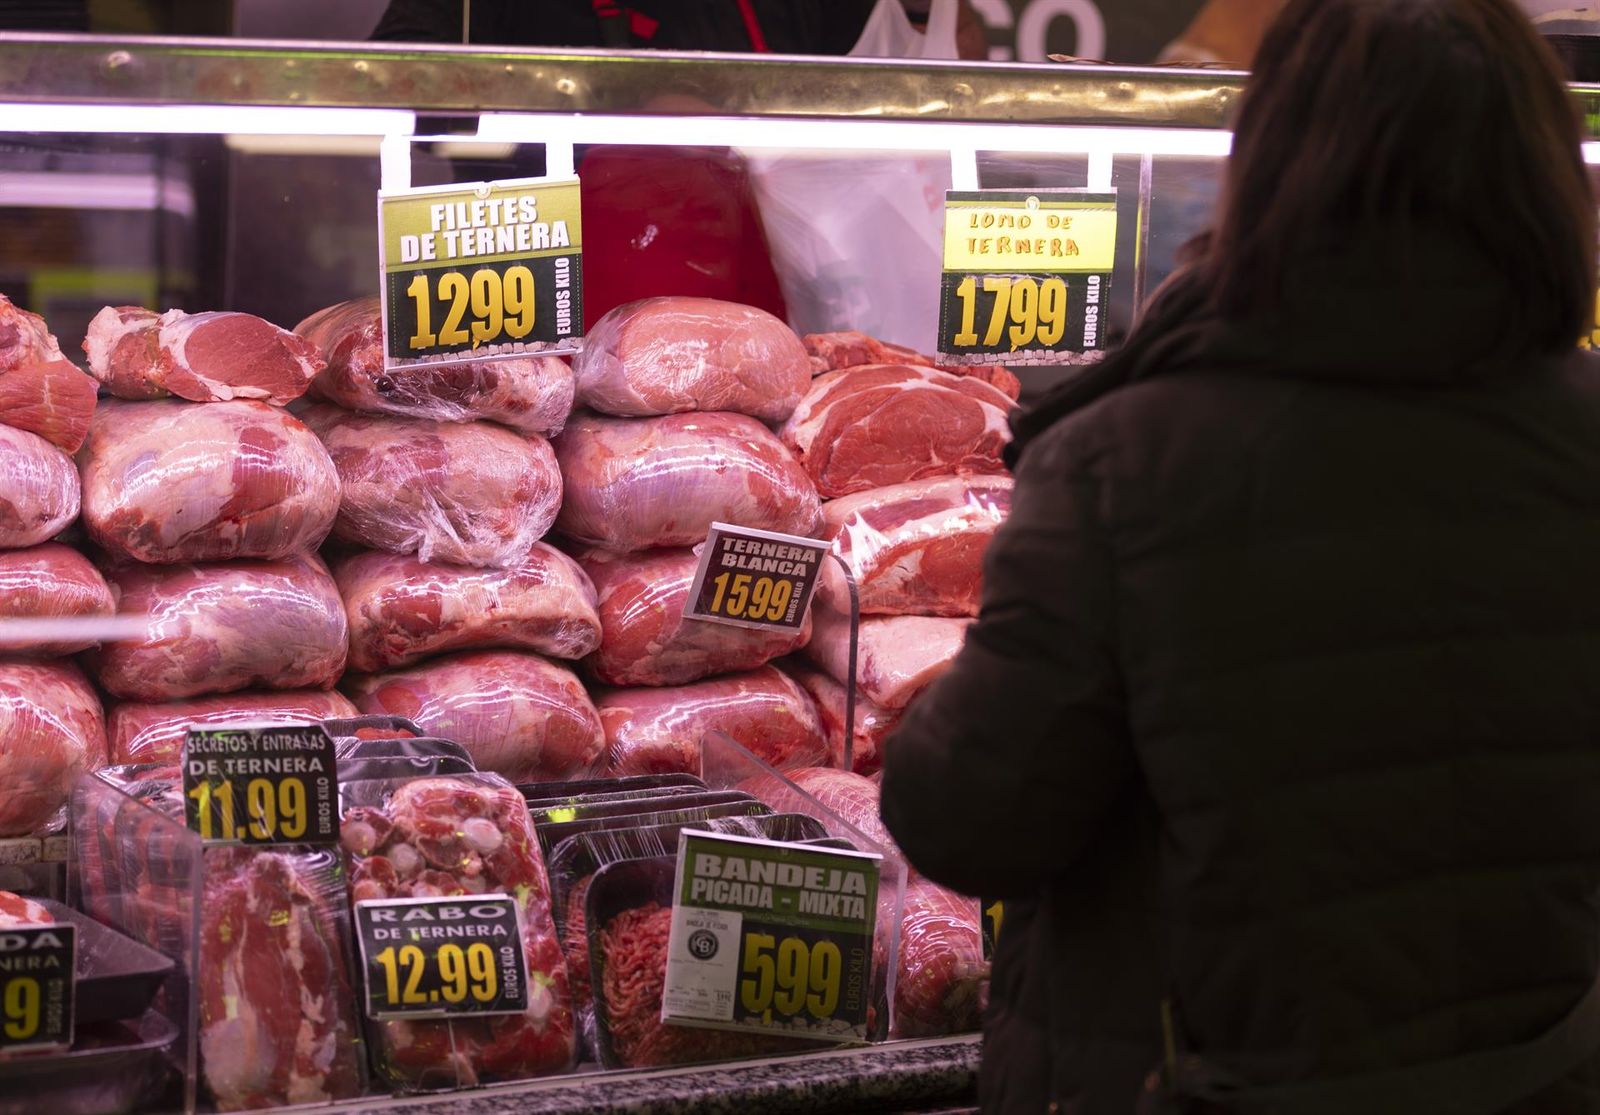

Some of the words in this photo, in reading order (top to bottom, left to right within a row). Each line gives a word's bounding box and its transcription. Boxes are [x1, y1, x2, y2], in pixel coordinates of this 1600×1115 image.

[430, 195, 537, 232] FILETES
[970, 213, 1032, 229] LOMO
[1046, 215, 1073, 230] DE
[400, 233, 436, 263] DE
[443, 220, 570, 258] TERNERA
[966, 236, 1081, 257] TERNERA
[555, 257, 570, 288] KILO
[1086, 275, 1101, 304] KILO
[555, 289, 571, 335] EUROS
[1083, 305, 1099, 347] EUROS
[721, 553, 807, 577] BLANCA
[722, 537, 816, 563] TERNERA
[785, 599, 799, 623] EUROS
[793, 581, 804, 599] KILO
[188, 735, 247, 754] SECRETOS
[250, 735, 260, 751] Y
[189, 760, 218, 776] DE
[224, 757, 324, 774] TERNERA
[316, 777, 329, 799] KILO
[188, 777, 307, 840] 11.99
[318, 800, 331, 834] EUROS
[694, 852, 867, 896] BANDEJA
[370, 905, 507, 923] RABO
[690, 878, 774, 909] PICADA
[798, 889, 865, 920] MIXTA
[374, 928, 401, 940] DE
[408, 924, 508, 939] TERNERA
[500, 946, 515, 968] KILO
[376, 942, 498, 1005] 12.99
[502, 968, 519, 999] EUROS
[4, 977, 40, 1039] 9
